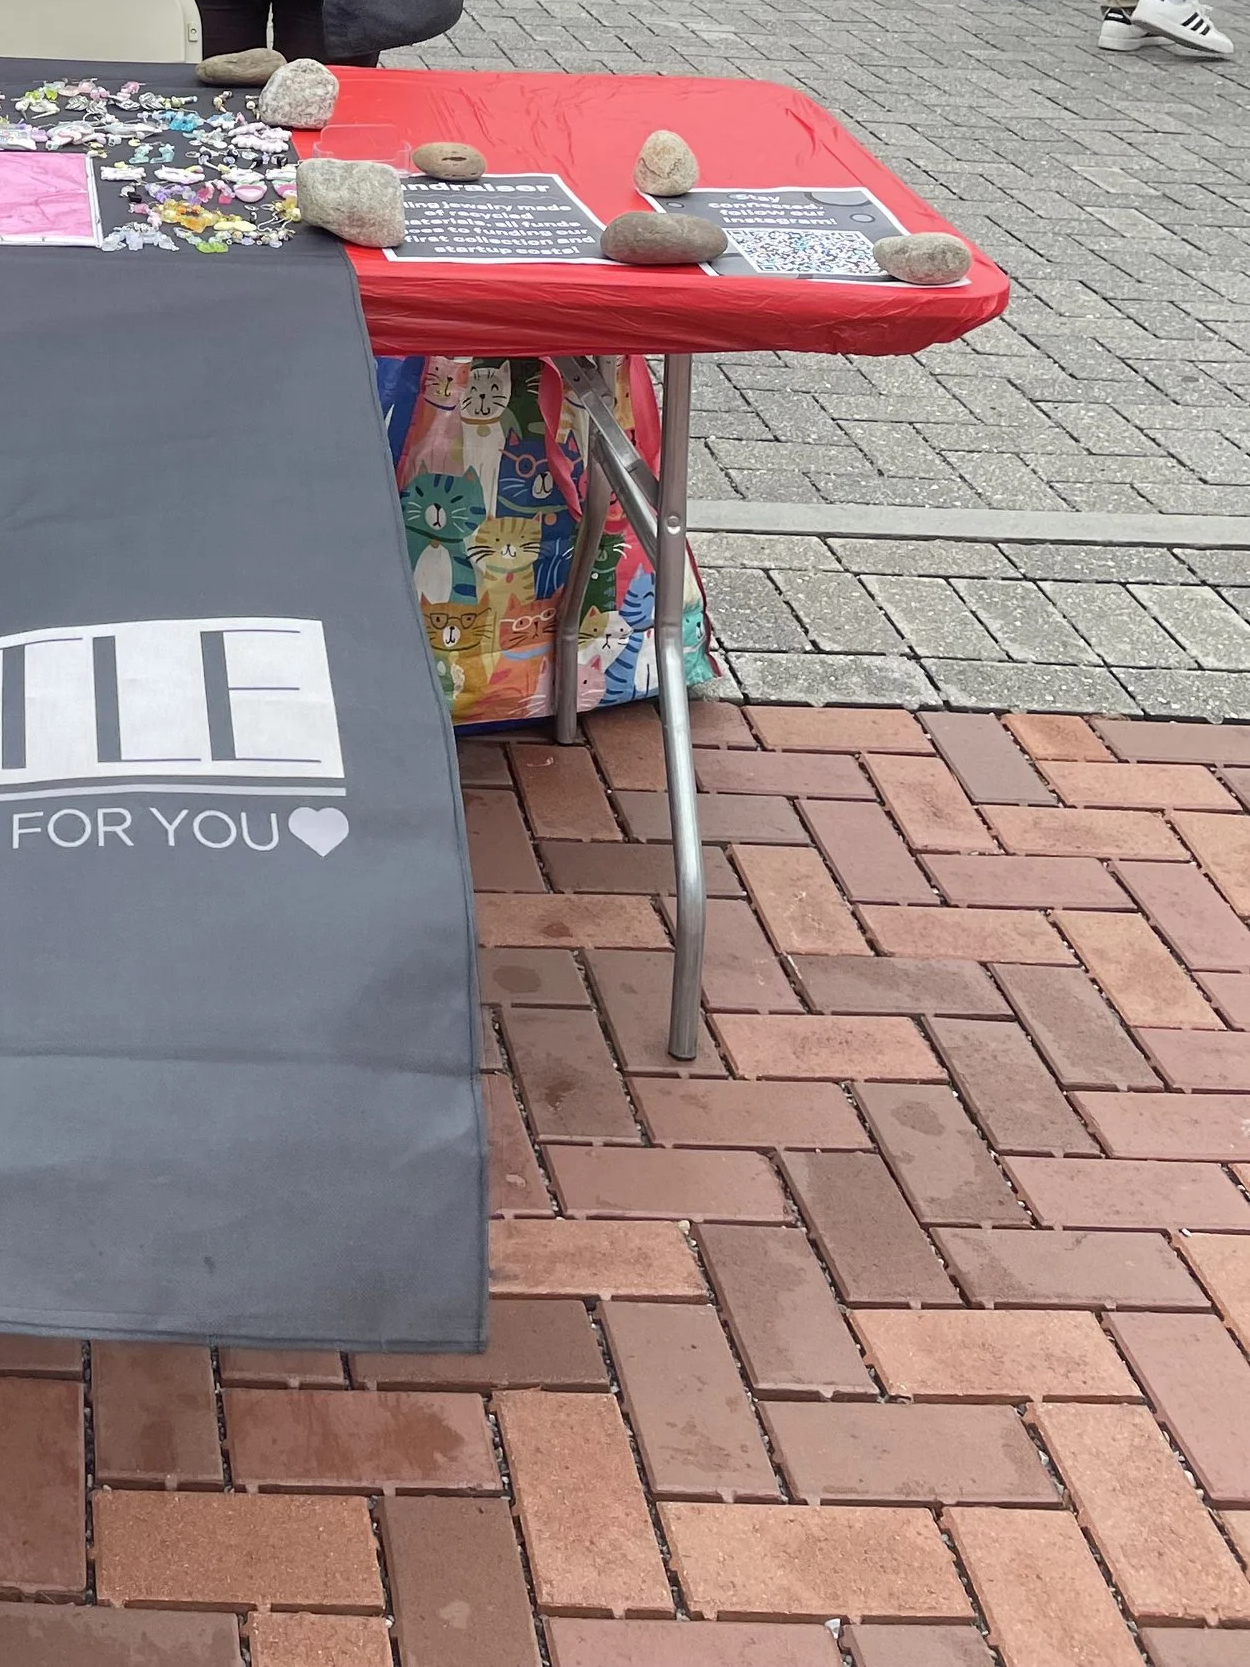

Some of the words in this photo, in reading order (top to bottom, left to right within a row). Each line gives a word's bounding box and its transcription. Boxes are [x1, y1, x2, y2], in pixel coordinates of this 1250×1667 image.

[401, 182, 550, 192] ndraiser
[449, 211, 534, 220] recycled
[495, 220, 519, 228] all
[473, 227, 553, 237] funding
[404, 235, 450, 243] first
[452, 235, 554, 246] collection
[556, 235, 596, 244] and
[433, 245, 513, 254] startup
[12, 807, 134, 850] FOR
[149, 806, 281, 852] YOU
